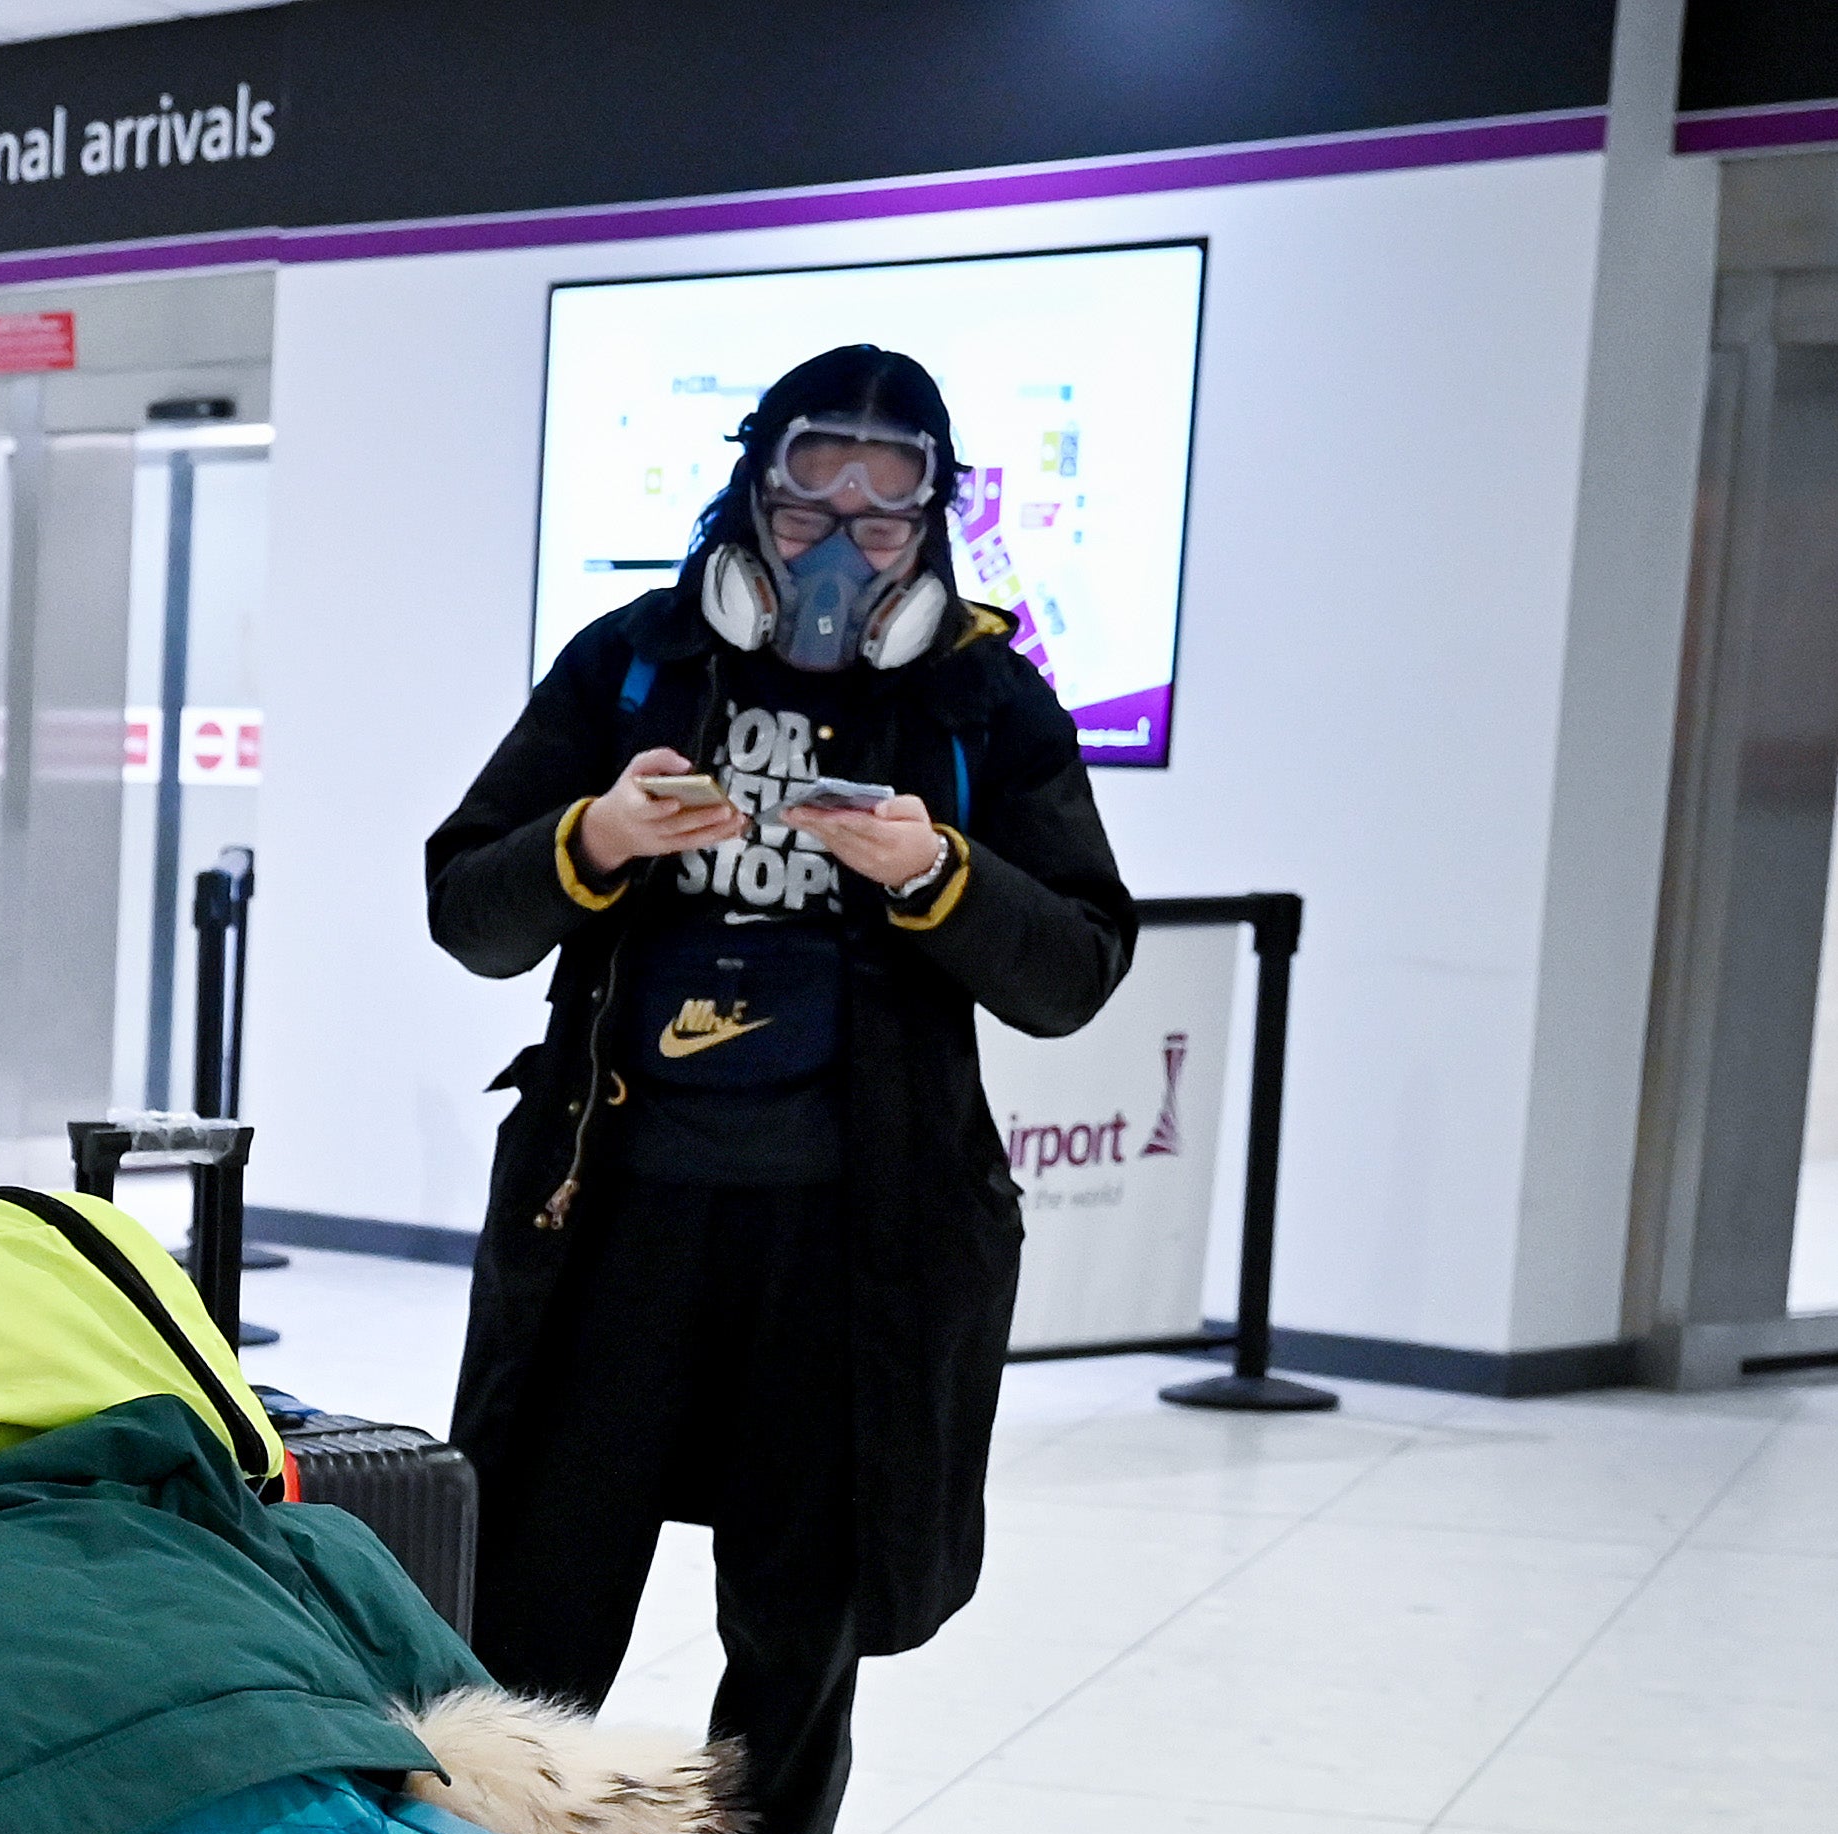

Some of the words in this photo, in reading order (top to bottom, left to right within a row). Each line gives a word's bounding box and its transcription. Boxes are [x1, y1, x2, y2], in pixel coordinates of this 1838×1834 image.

[80, 81, 276, 176] arrivals
[677, 837, 842, 914] STOP
[1008, 1112, 1126, 1178] irport
